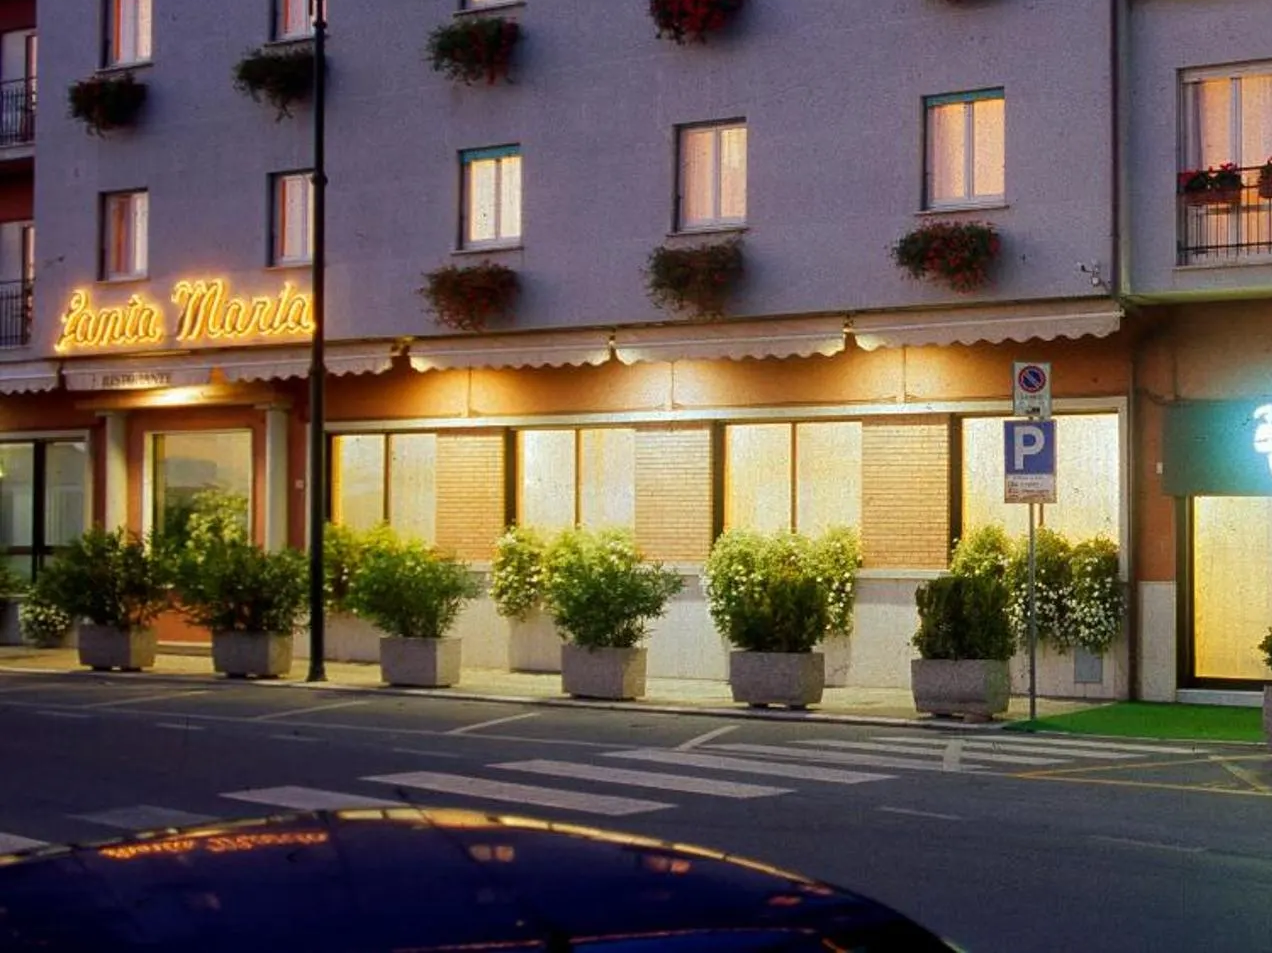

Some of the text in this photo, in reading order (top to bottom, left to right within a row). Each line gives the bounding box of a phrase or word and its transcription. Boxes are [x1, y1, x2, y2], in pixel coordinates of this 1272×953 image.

[54, 278, 315, 351] Santa Maria
[1014, 426, 1045, 470] P
